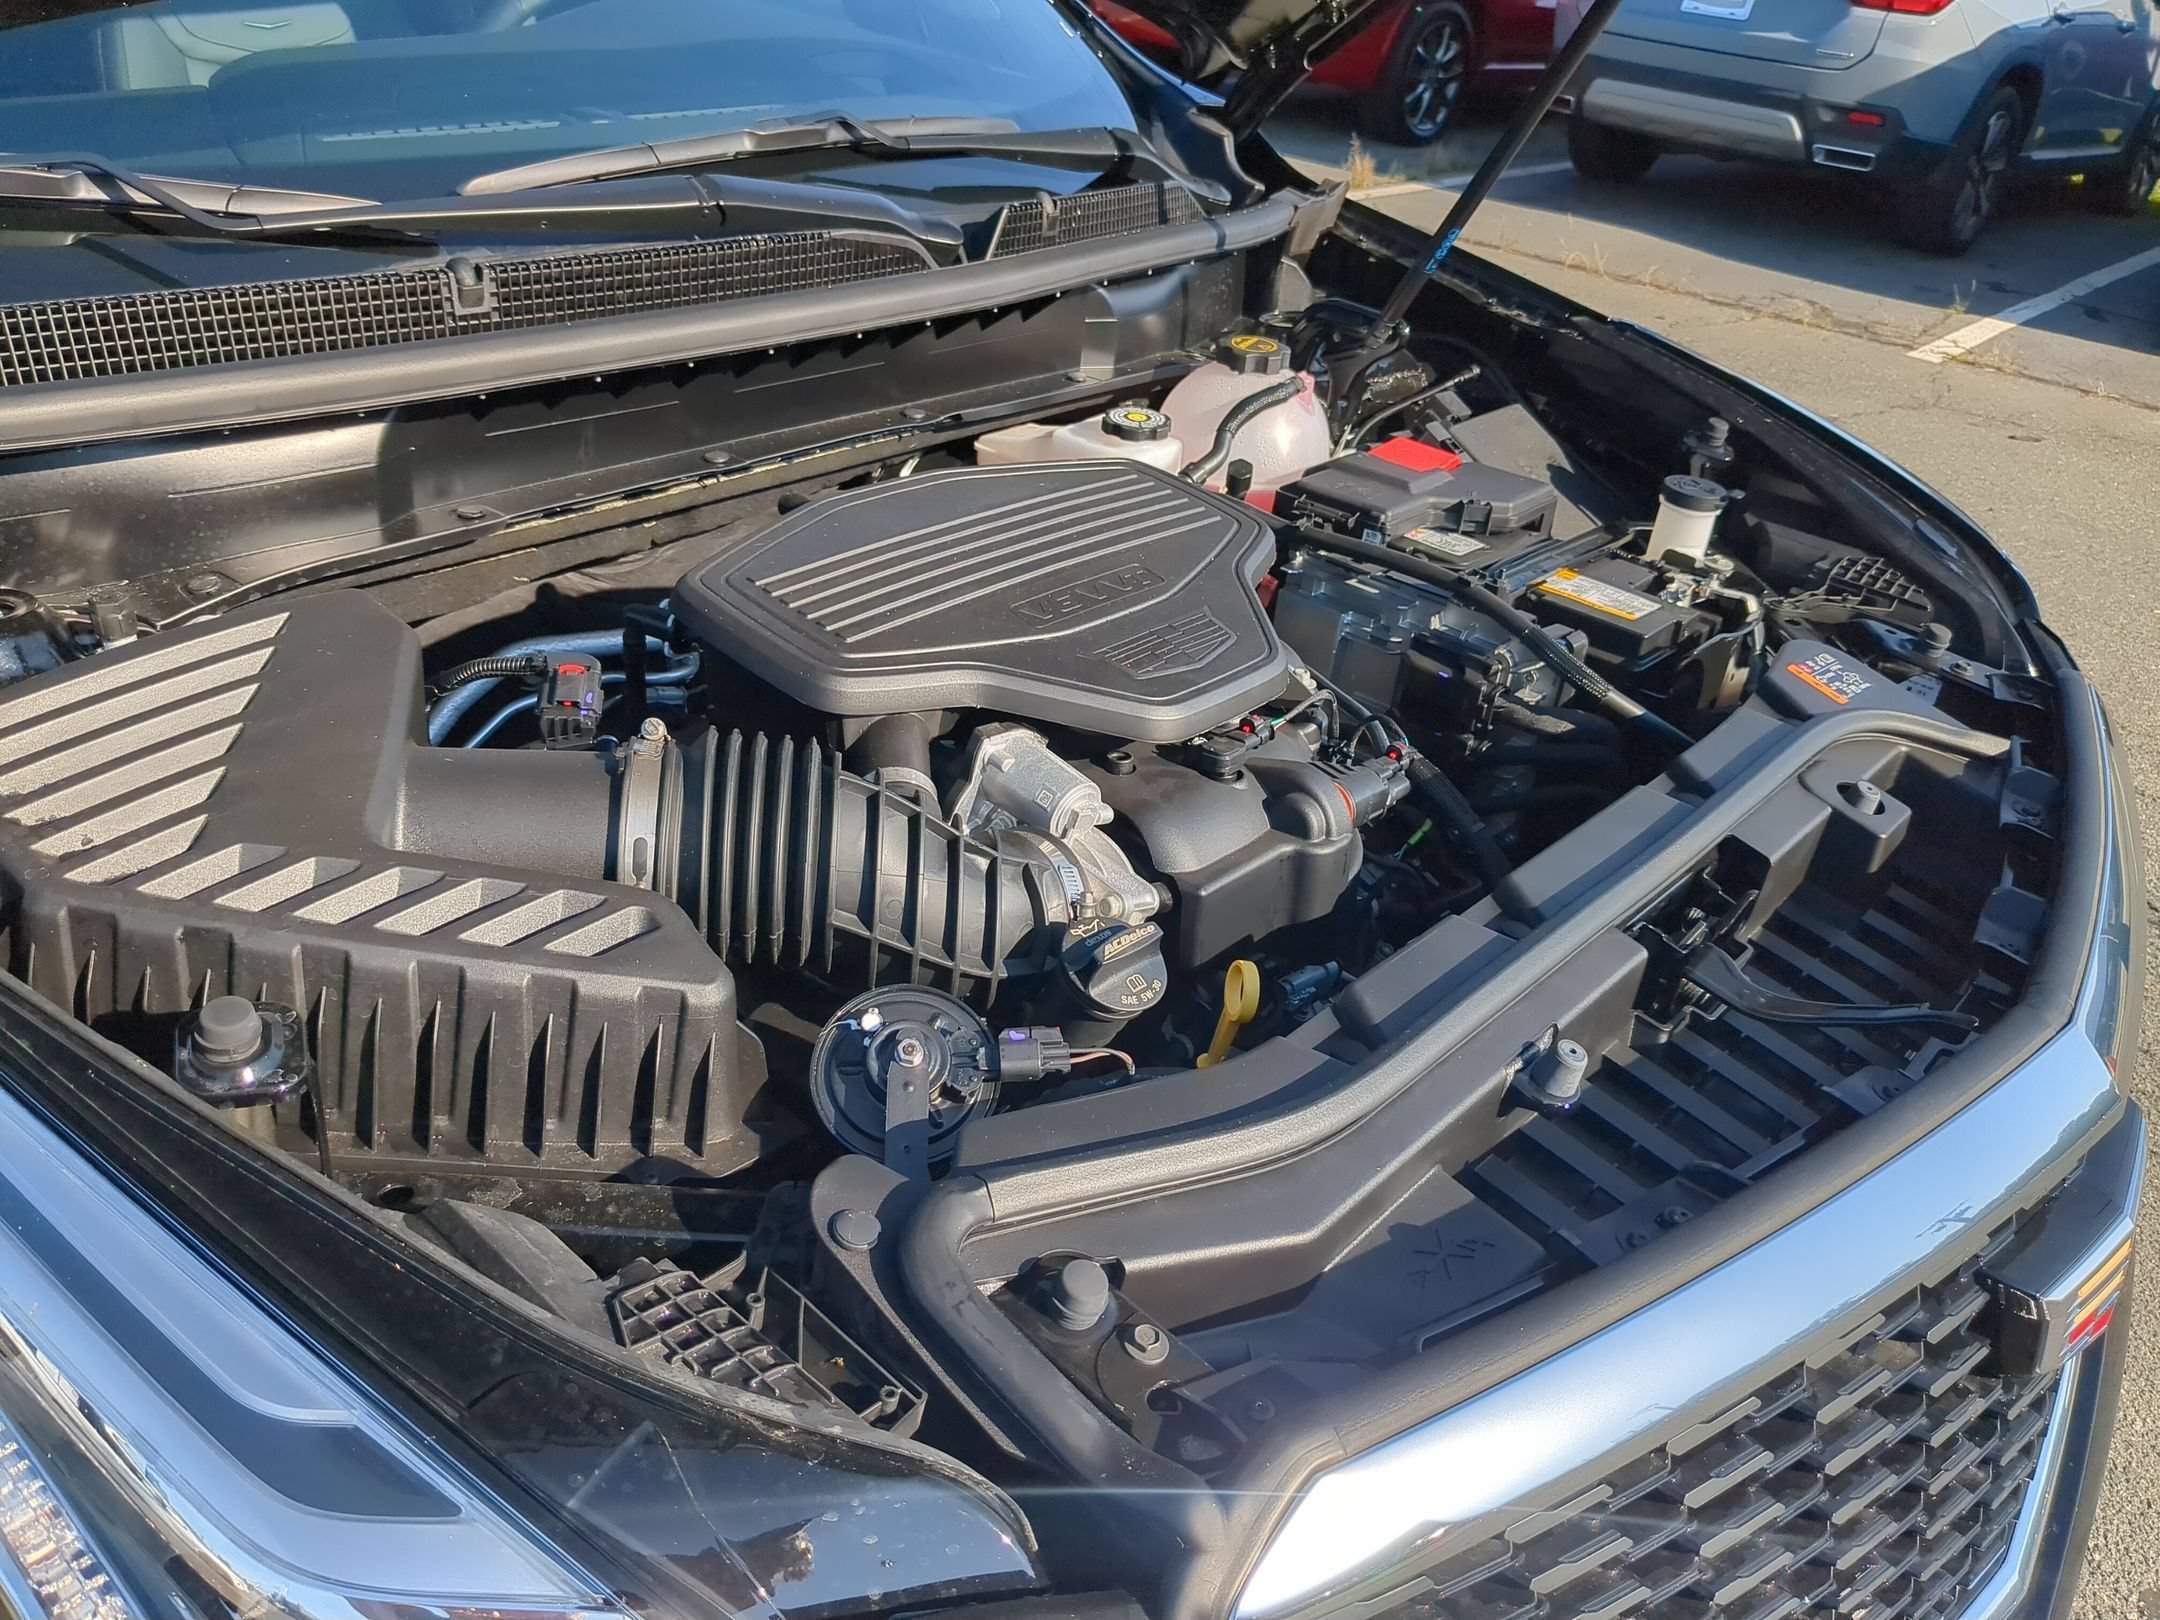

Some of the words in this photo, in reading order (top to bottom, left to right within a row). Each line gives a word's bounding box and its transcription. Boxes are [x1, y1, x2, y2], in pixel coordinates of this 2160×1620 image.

[1104, 925, 1155, 956] ACDelco
[1121, 995, 1139, 1005] SAE
[1141, 979, 1162, 1002] 5W-30
